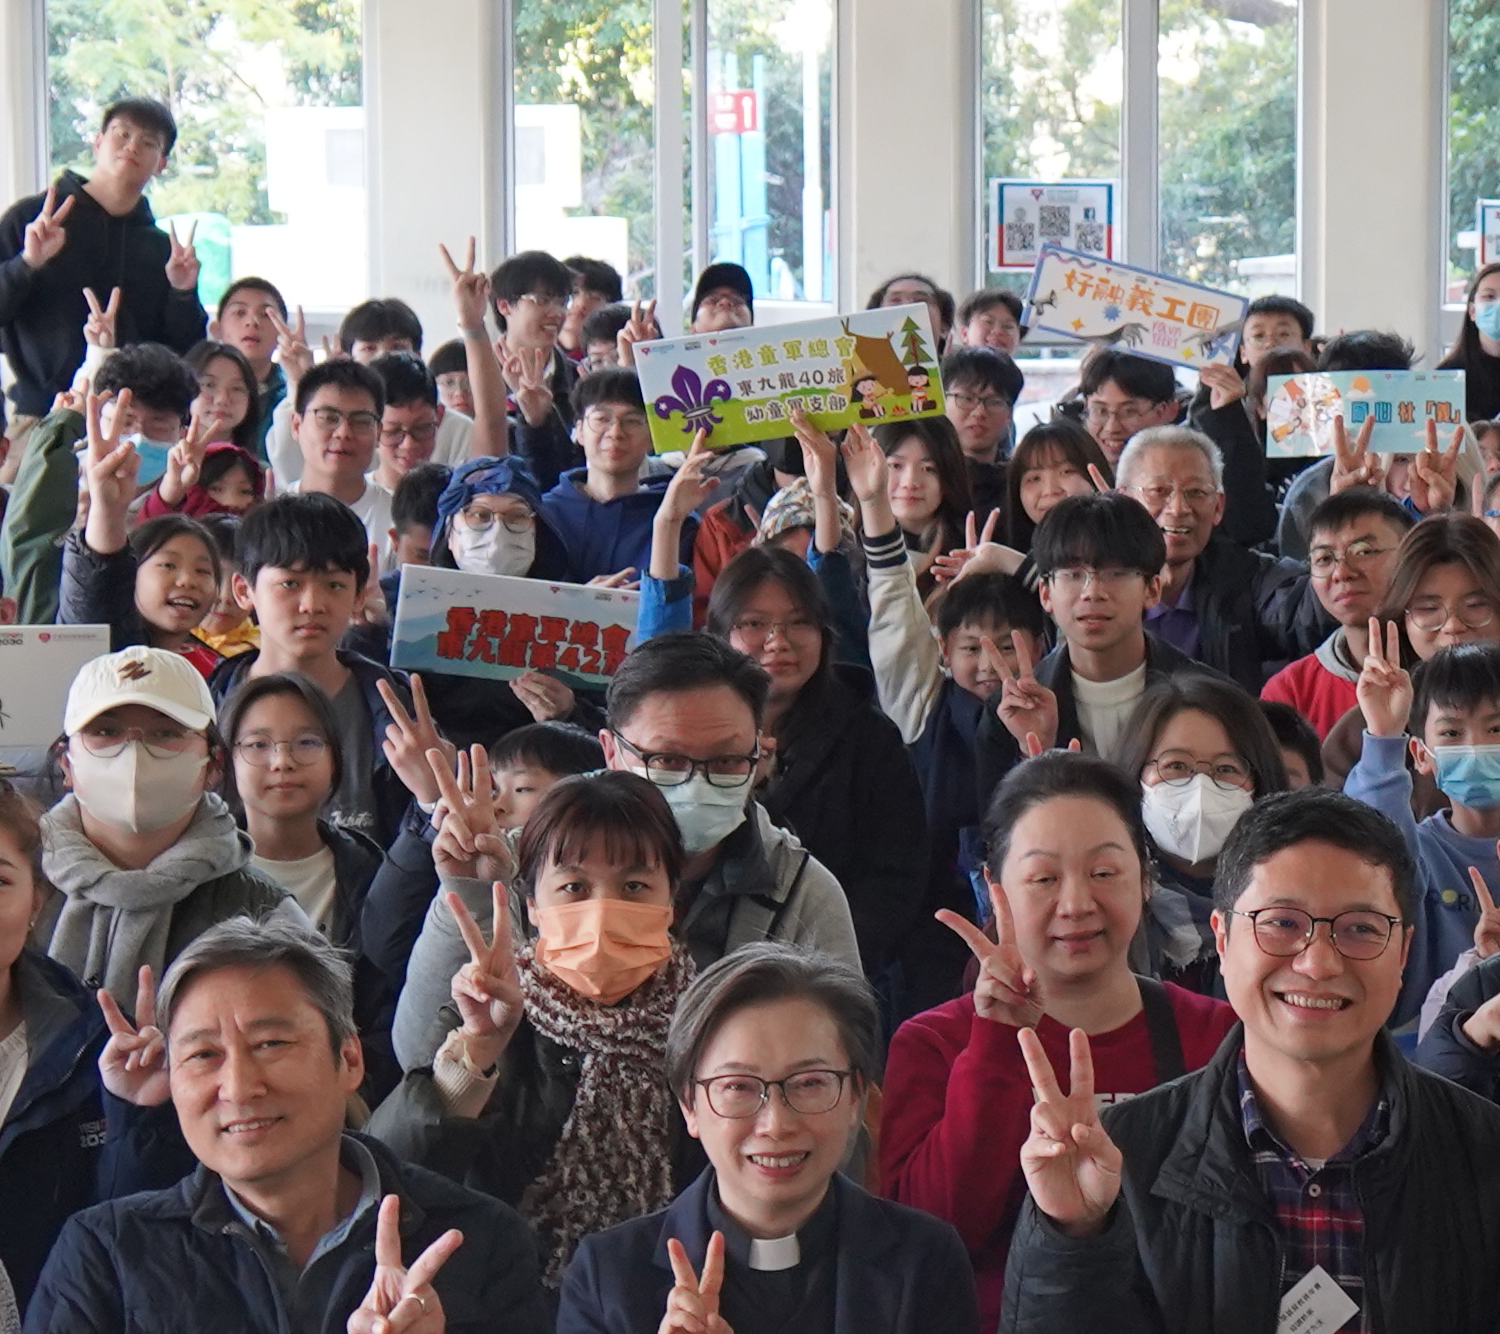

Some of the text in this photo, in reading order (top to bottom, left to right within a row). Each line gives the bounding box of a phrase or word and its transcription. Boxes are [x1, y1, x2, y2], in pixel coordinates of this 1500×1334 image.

[706, 336, 857, 376] 香港童軍總會
[736, 367, 847, 397] 東九龍40旅
